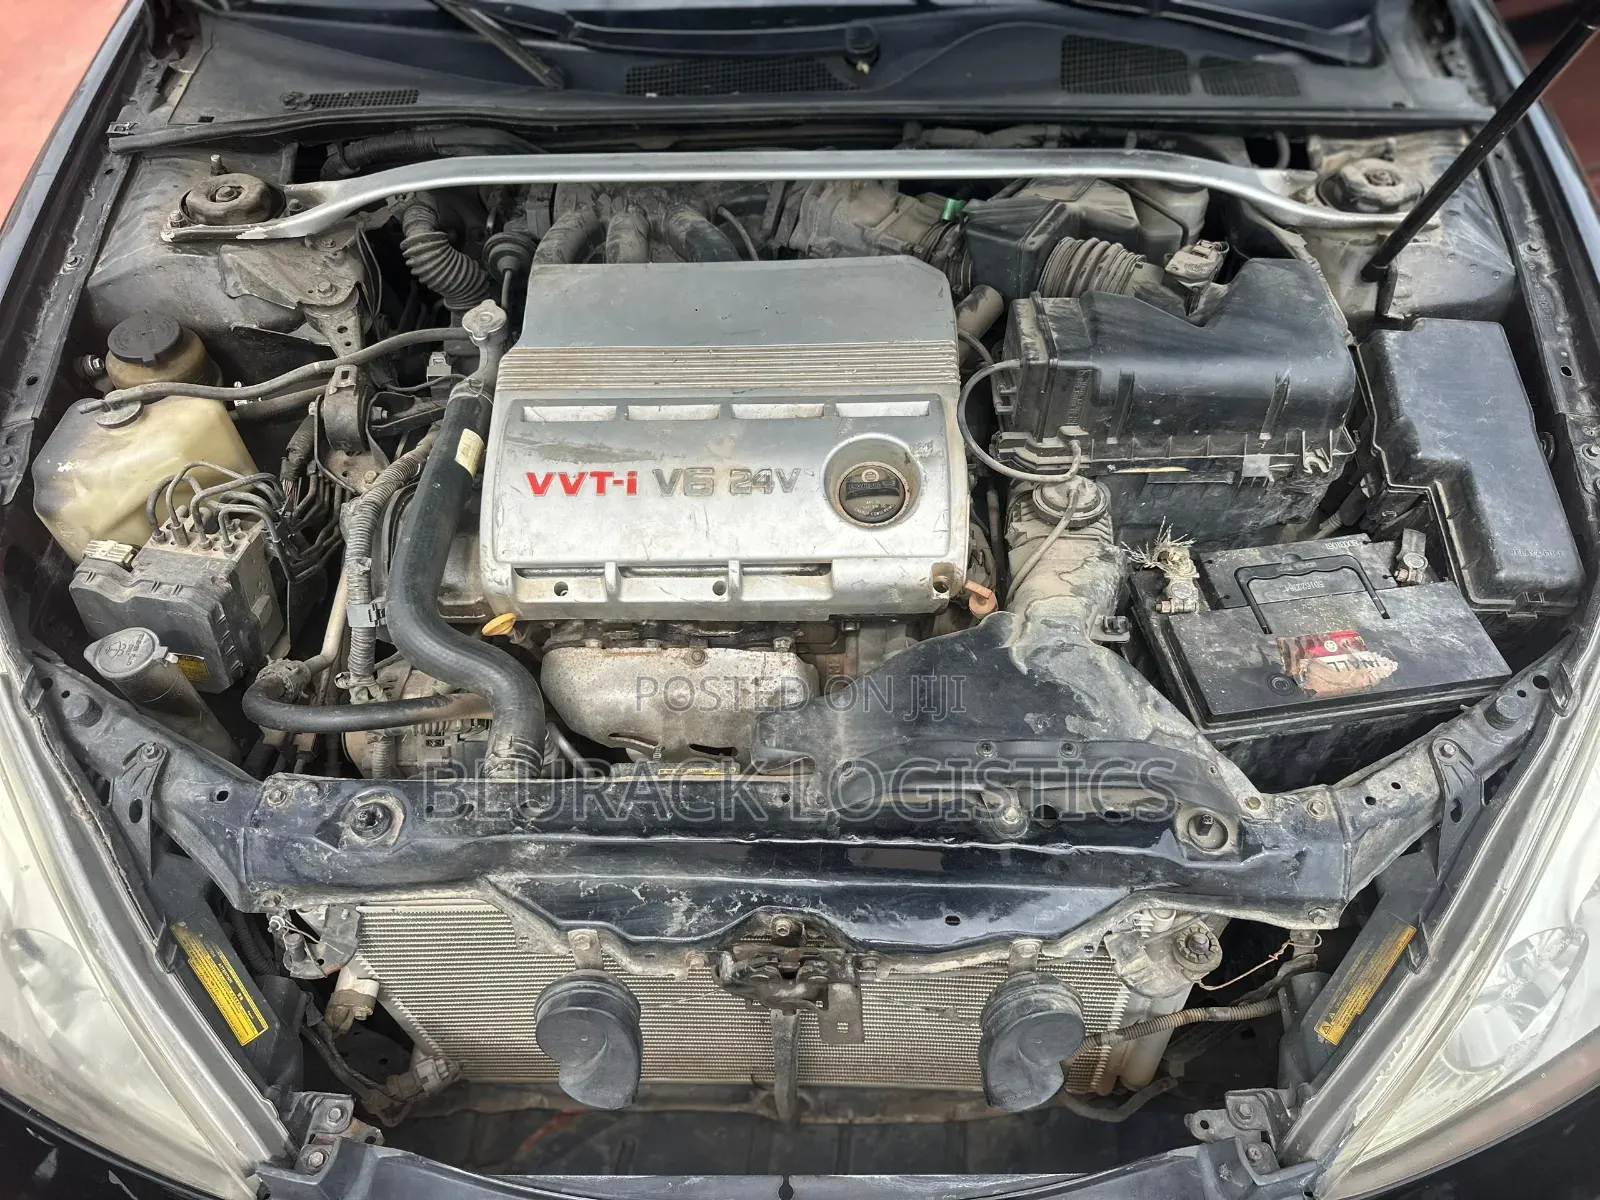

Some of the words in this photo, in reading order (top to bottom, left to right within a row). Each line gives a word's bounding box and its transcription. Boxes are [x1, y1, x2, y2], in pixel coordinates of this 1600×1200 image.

[526, 471, 639, 496] VVT-i
[652, 467, 716, 497] V6
[729, 467, 801, 496] 24V
